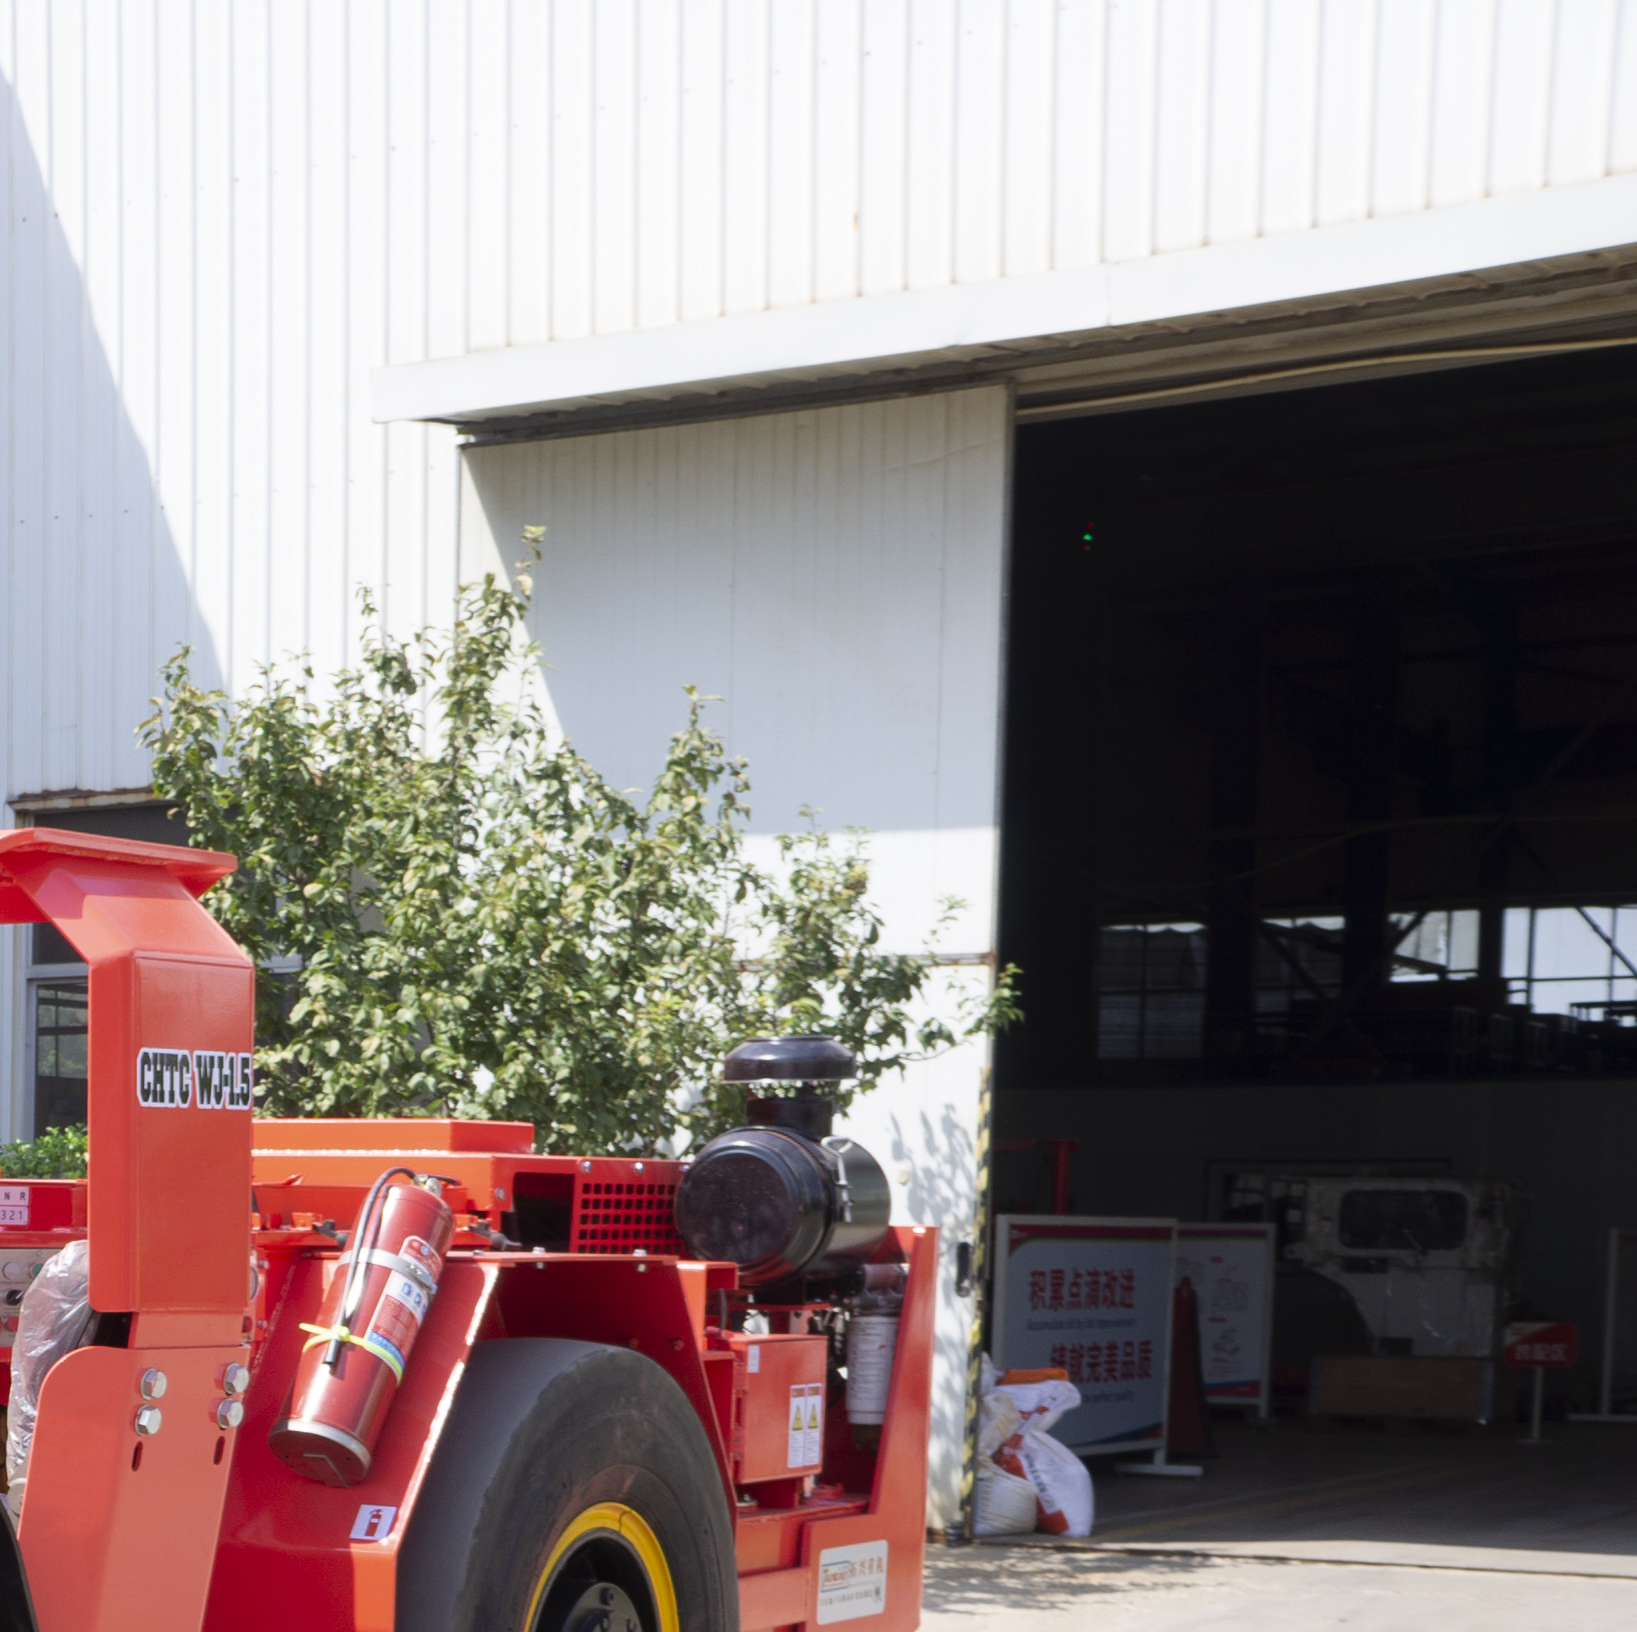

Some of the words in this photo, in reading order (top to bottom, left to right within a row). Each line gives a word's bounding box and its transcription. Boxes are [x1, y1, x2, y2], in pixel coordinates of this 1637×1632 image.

[139, 1050, 190, 1106] CHTC
[195, 1052, 251, 1108] WJ-1.5
[4, 1191, 10, 1201] N
[19, 1191, 26, 1201] R
[1029, 1267, 1135, 1311] 积累点滴改进
